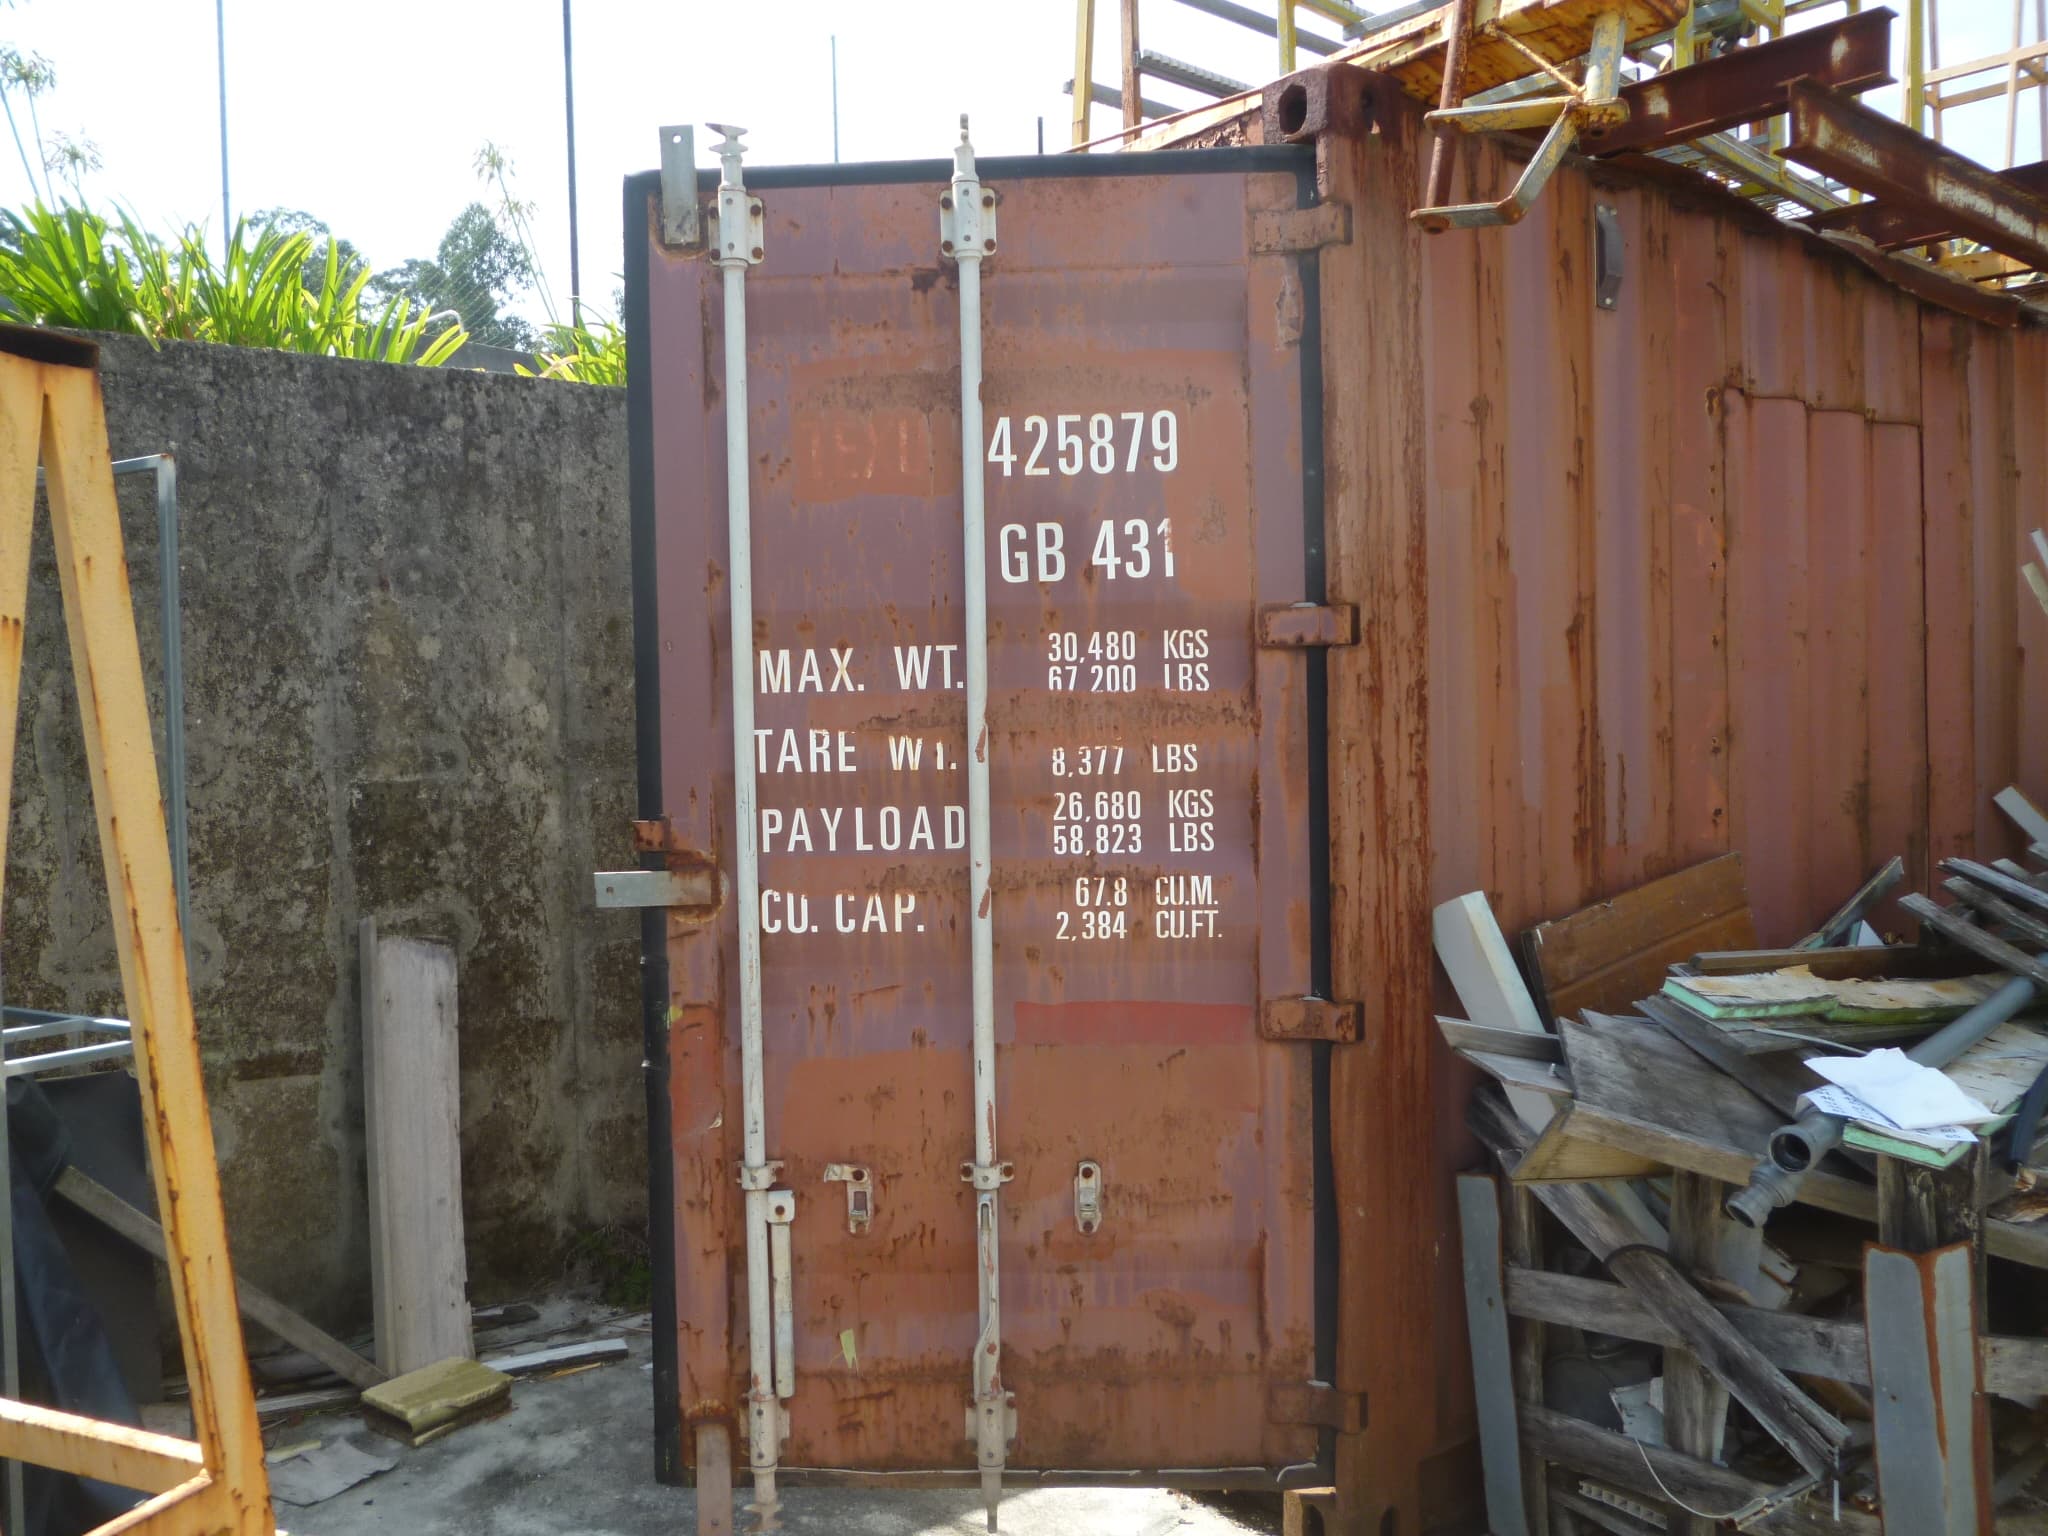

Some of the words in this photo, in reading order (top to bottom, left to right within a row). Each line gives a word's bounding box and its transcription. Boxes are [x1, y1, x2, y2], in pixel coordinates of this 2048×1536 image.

[987, 409, 1179, 477] 425879
[999, 522, 1066, 584] GB
[1091, 517, 1175, 580] 431
[1048, 631, 1137, 664] 30,480
[1163, 629, 1209, 660] KGS
[759, 647, 865, 694] MAX.
[893, 644, 965, 690] WT.
[1048, 665, 1137, 693] 67200
[1164, 663, 1210, 692] LBS
[754, 728, 857, 774] TARE
[1052, 744, 1125, 778] 8,377
[1152, 743, 1198, 774] LBS
[1054, 790, 1142, 823] 26,680
[1168, 788, 1214, 818] KGS
[762, 805, 966, 853] PAYLOAD
[1053, 824, 1143, 856] 58,823
[1169, 821, 1216, 852] LBS
[1075, 876, 1129, 907] 67.8
[1155, 874, 1219, 906] CU.M.
[761, 888, 819, 934] CU.
[834, 889, 926, 934] CAP.
[1055, 909, 1128, 942] 2,384
[1155, 908, 1223, 939] CU.FT.
